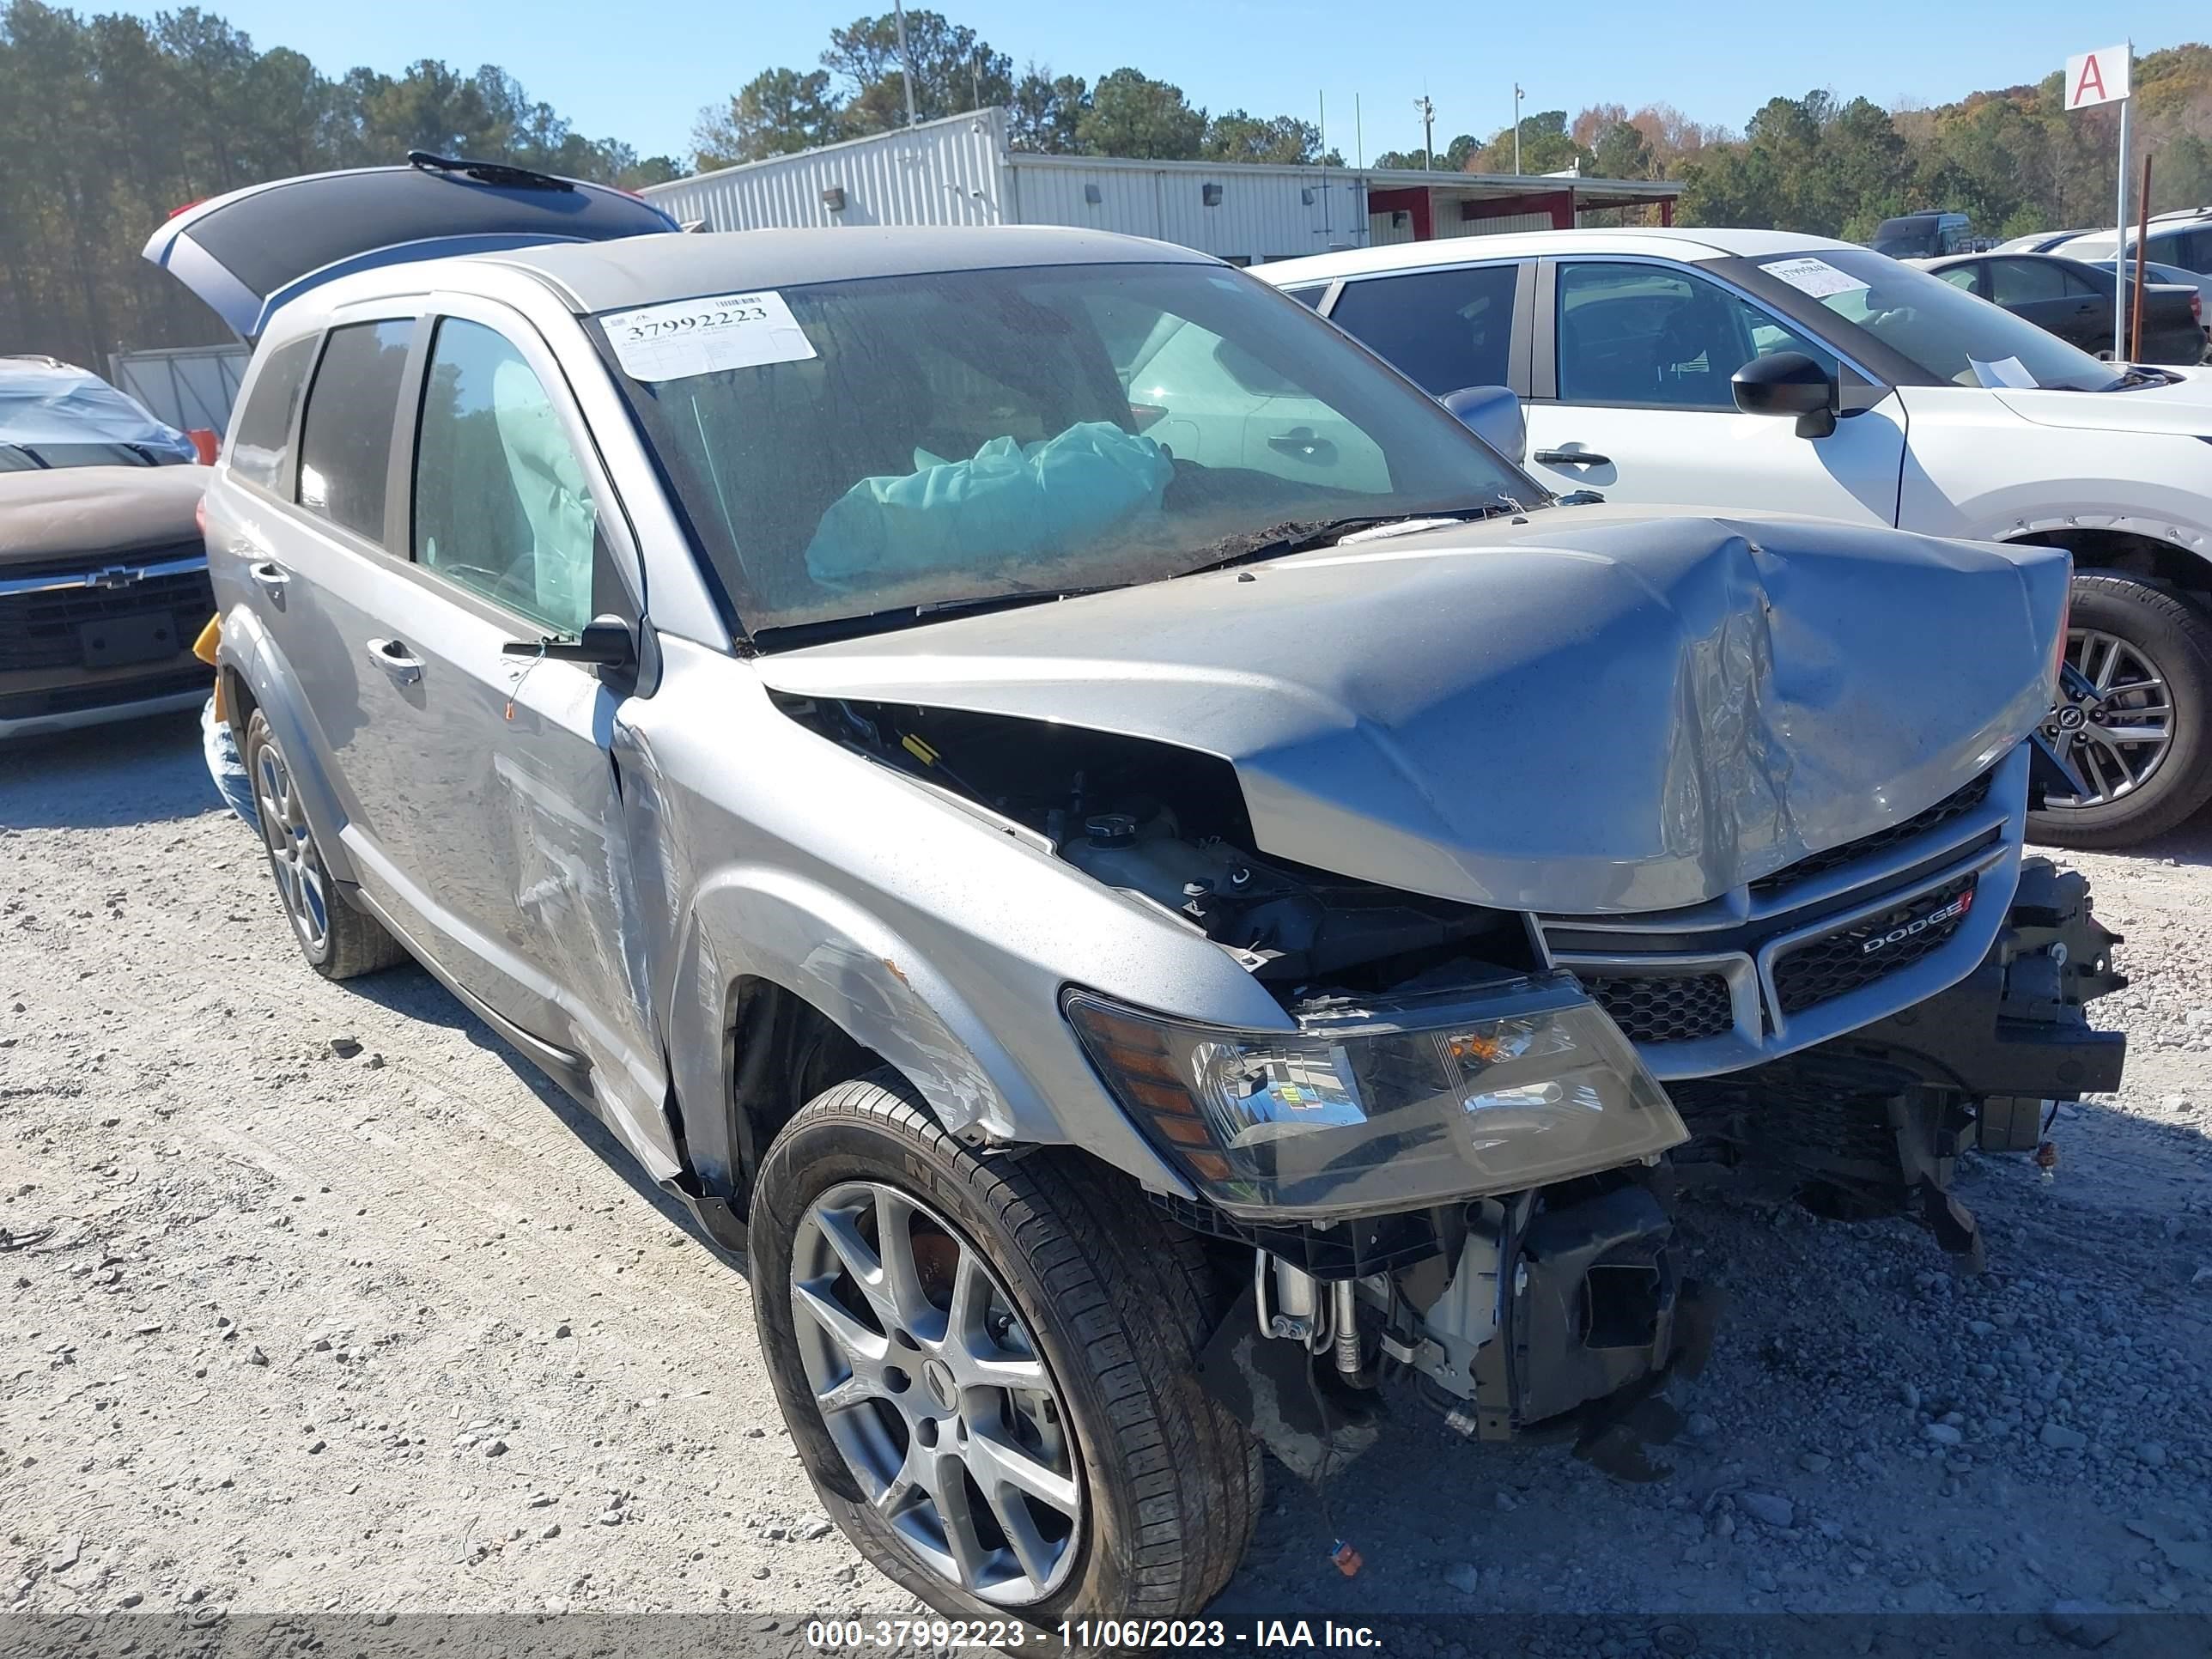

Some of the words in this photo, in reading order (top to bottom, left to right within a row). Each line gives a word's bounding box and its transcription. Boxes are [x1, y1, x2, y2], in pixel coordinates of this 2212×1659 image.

[2074, 54, 2106, 106] A
[626, 307, 768, 341] 37992223
[1863, 900, 1964, 953] DODGE
[904, 1153, 1048, 1335] NEXEN
